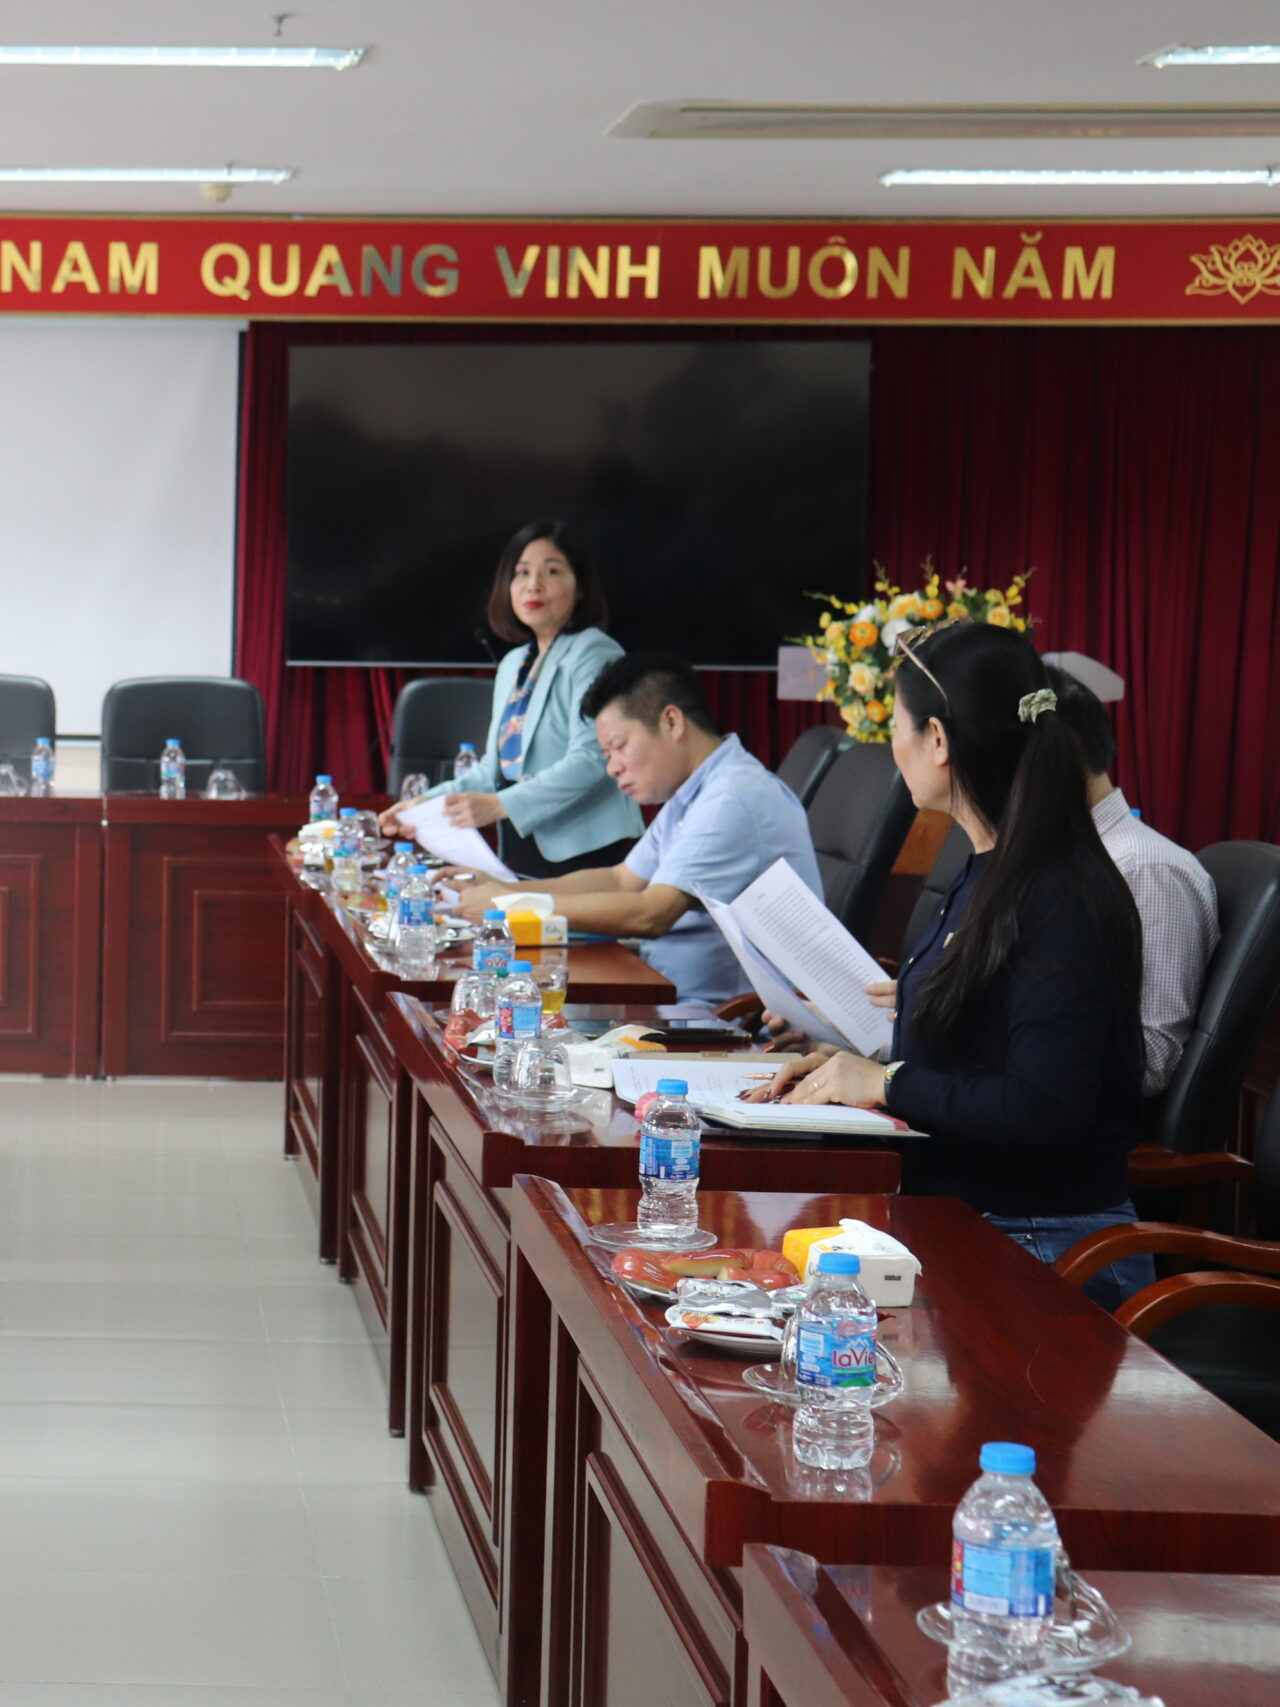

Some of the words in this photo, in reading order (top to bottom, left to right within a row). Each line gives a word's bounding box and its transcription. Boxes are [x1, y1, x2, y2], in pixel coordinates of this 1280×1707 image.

[0, 239, 160, 296] NAM
[200, 241, 460, 304] QUANG
[495, 244, 661, 300] VINH
[697, 233, 910, 300] MUÔN
[951, 231, 1116, 300] NĂM
